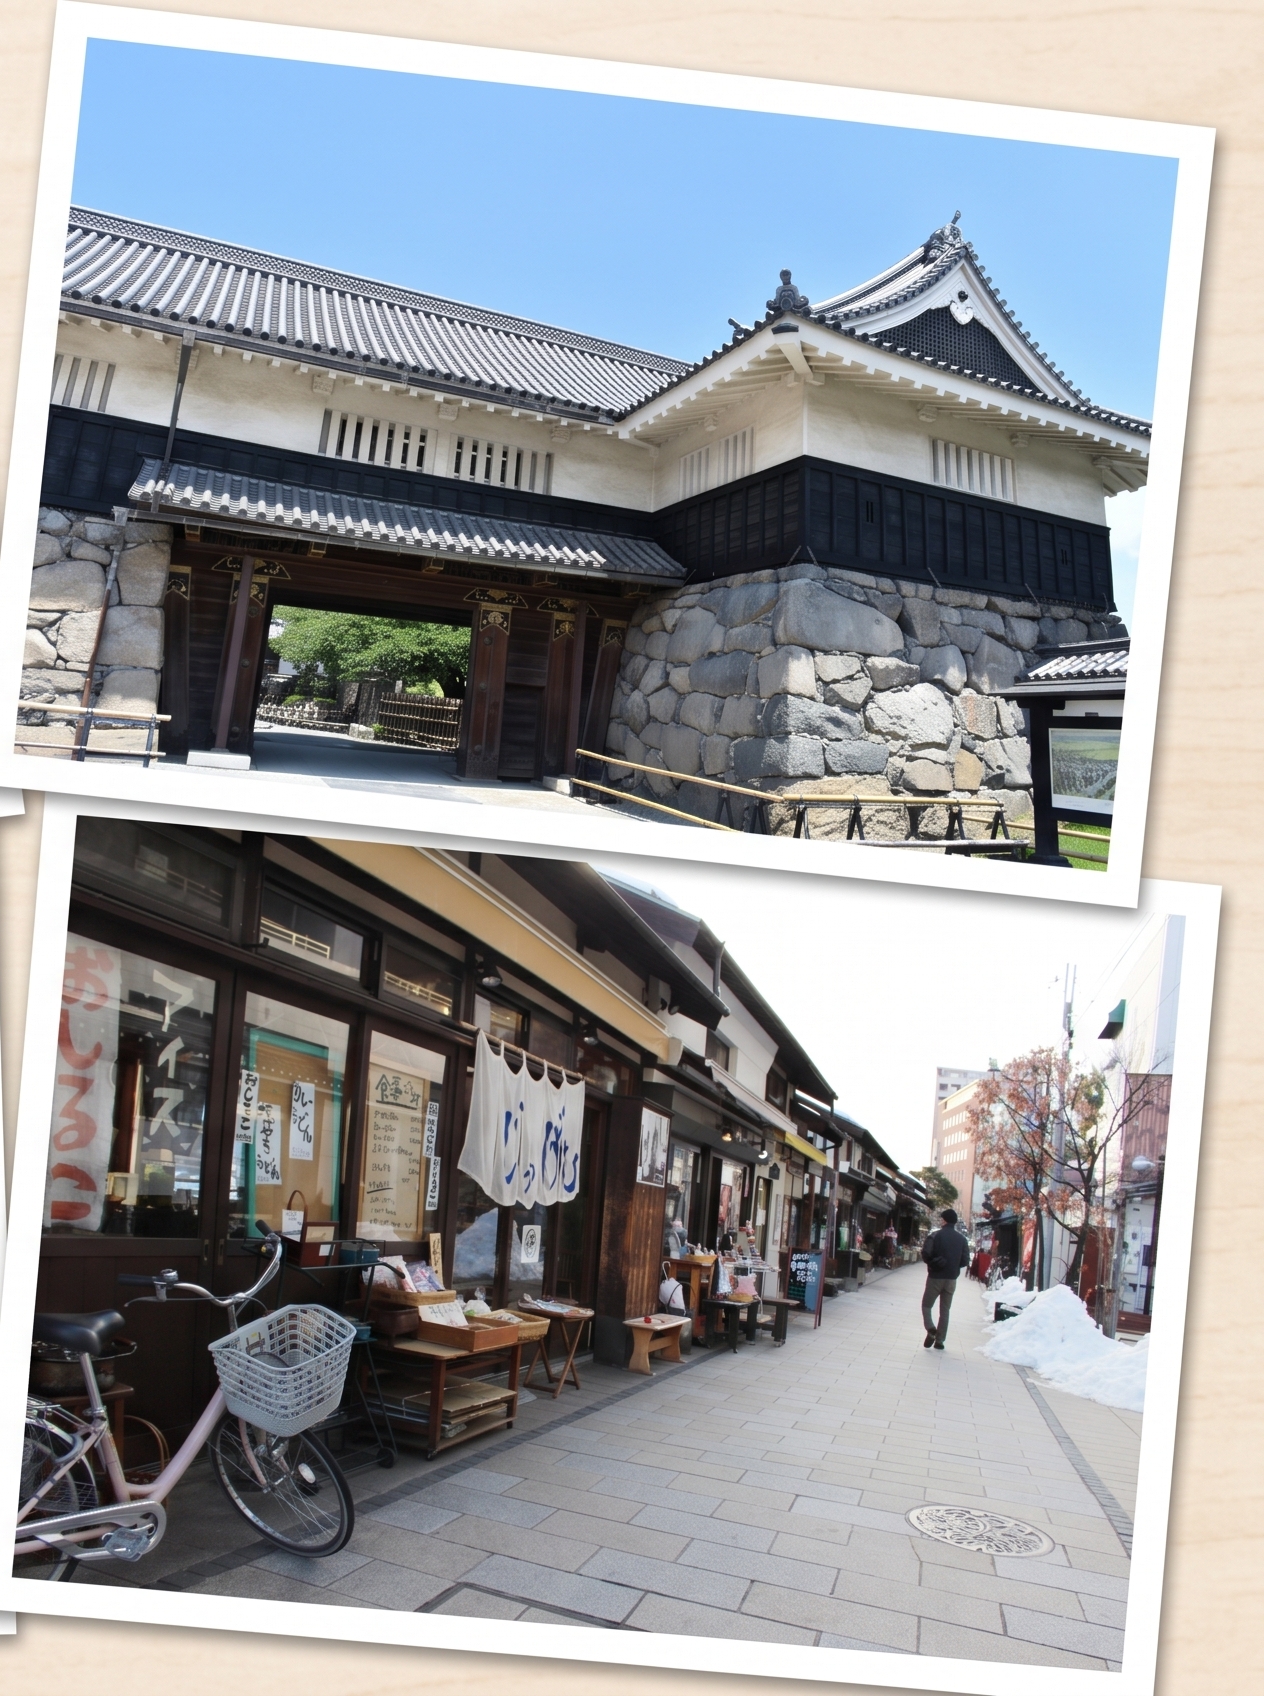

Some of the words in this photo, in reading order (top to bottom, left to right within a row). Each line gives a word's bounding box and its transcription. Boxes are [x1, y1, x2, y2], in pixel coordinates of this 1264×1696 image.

[51, 946, 114, 1220] おしるこ
[149, 968, 195, 1138] アイス
